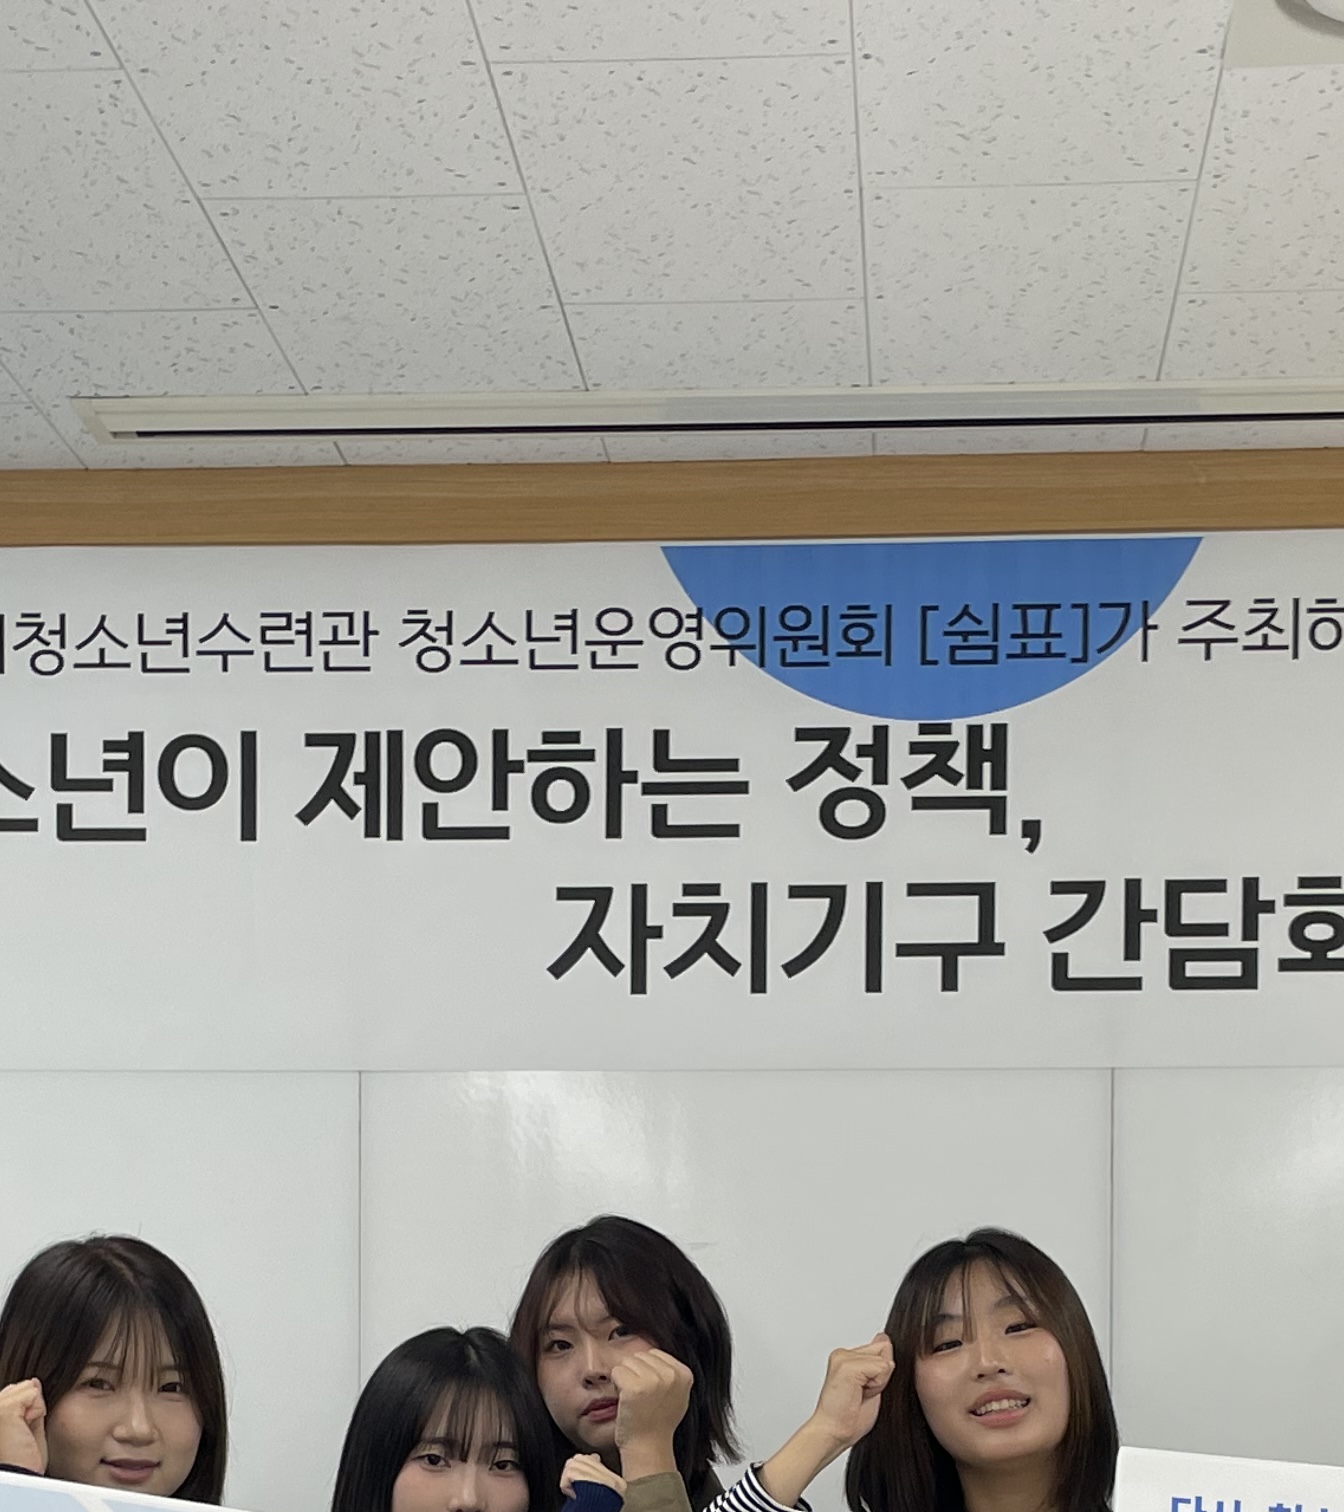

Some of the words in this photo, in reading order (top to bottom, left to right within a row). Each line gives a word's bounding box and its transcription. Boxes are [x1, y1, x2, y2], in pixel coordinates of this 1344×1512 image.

[398, 603, 893, 674] 청소년운영위원회
[918, 598, 1160, 669] [쉼표]가
[296, 726, 750, 843] 제안하는
[785, 722, 1045, 854] 정책,
[545, 880, 1007, 996] 자치기구
